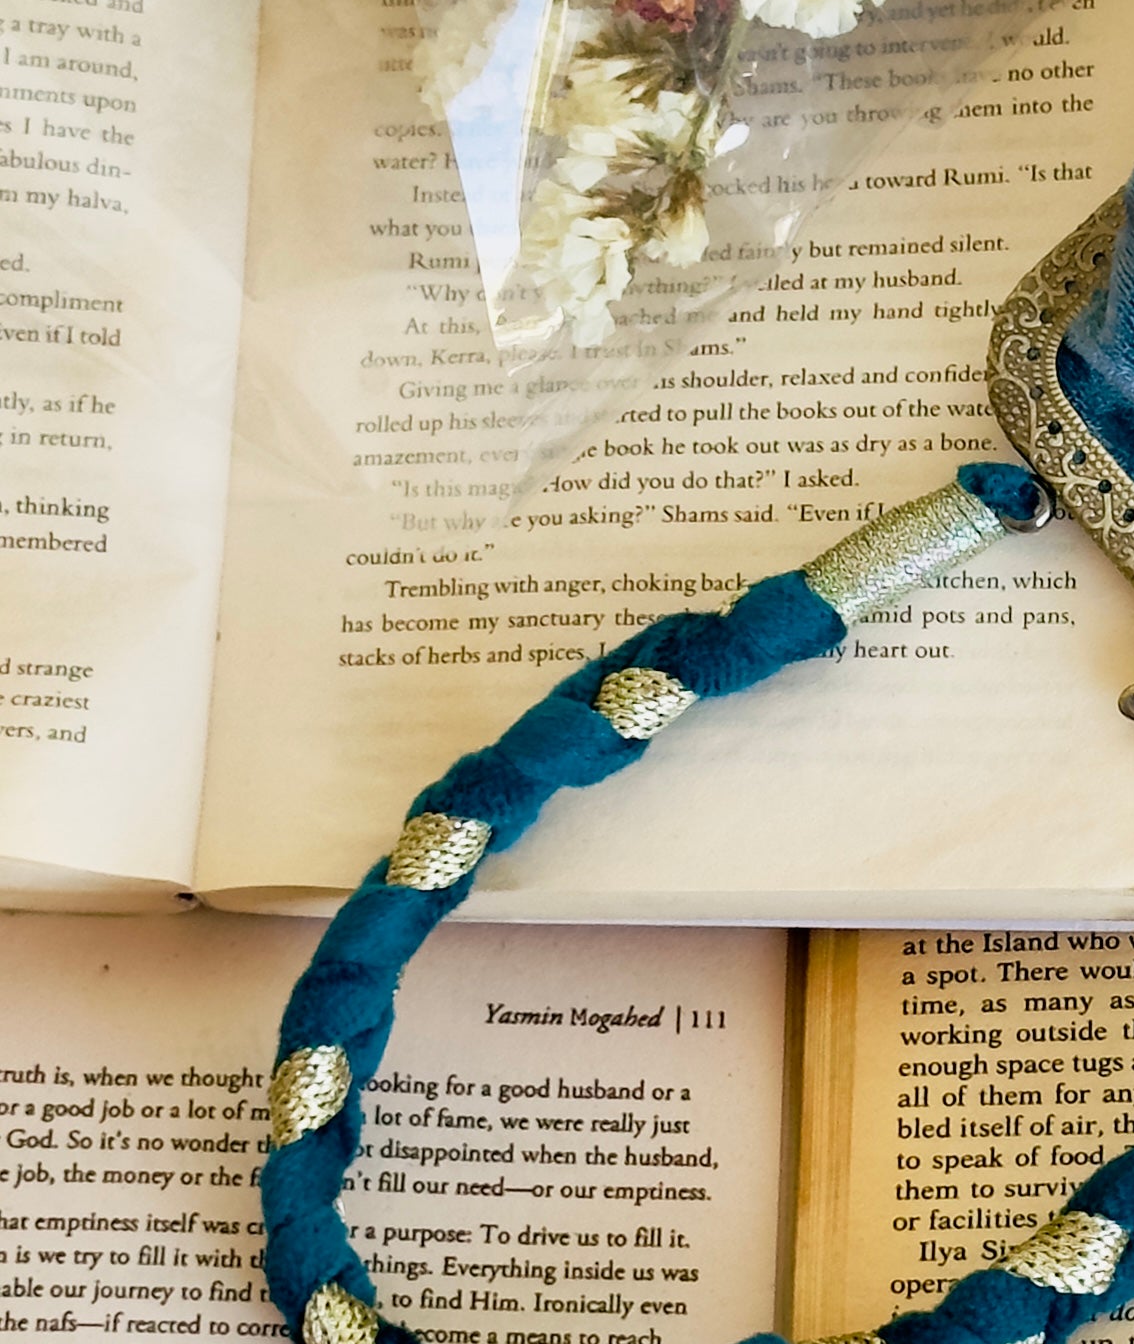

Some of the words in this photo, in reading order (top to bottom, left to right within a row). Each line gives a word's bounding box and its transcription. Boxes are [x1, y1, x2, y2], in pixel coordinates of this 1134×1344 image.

[10, 18, 22, 33] a
[27, 18, 71, 42] tray
[75, 24, 125, 45] with
[130, 33, 142, 47] a
[865, 167, 937, 190] toward
[943, 167, 1010, 187] Rumi.
[1052, 161, 1093, 182] that
[604, 436, 655, 458] book
[661, 436, 686, 456] he
[692, 435, 740, 455] took
[745, 439, 780, 455] out
[786, 440, 825, 454] was
[829, 439, 850, 453] as
[855, 433, 892, 458] dry
[897, 438, 917, 452] as
[922, 438, 934, 452] a
[940, 431, 998, 452] bone.
[15, 494, 110, 525] thinking
[921, 609, 966, 630] pots
[974, 604, 1013, 625] and
[1022, 611, 1076, 631] pans,
[16, 662, 94, 683] strange
[484, 1002, 564, 1027] Yasmin
[569, 1004, 667, 1035] Mogahed
[691, 1009, 727, 1031] 111
[364, 1225, 377, 1240] a
[381, 1226, 473, 1249] purpose:
[479, 1223, 511, 1245] To
[517, 1224, 571, 1247] drive
[577, 1232, 600, 1247] us
[606, 1232, 628, 1248] to
[633, 1225, 662, 1248] fill
[668, 1228, 691, 1249] it.
